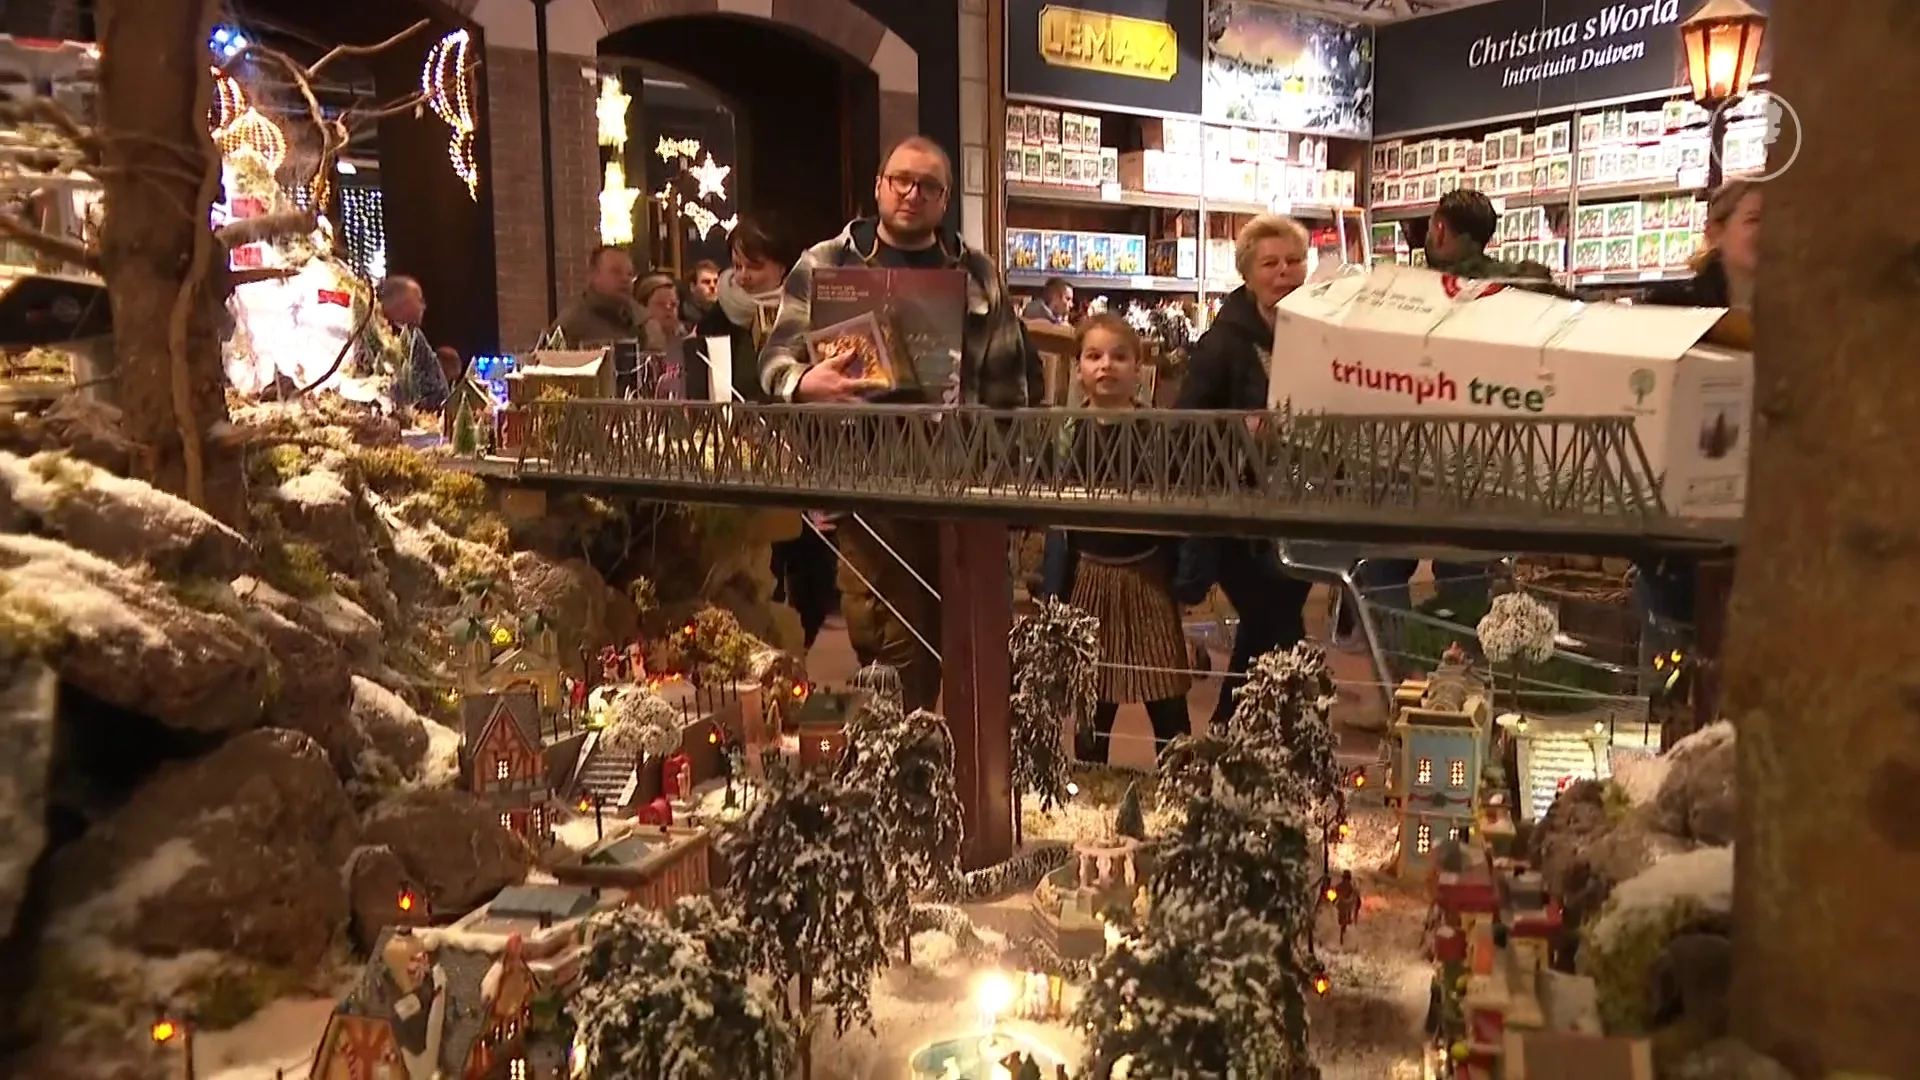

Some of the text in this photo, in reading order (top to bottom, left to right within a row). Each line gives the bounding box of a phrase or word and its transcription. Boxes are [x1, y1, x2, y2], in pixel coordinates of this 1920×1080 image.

[1044, 17, 1171, 72] LEMAX
[1502, 41, 1645, 88] Intratuin Duiven
[1332, 358, 1544, 412] triumph tree
